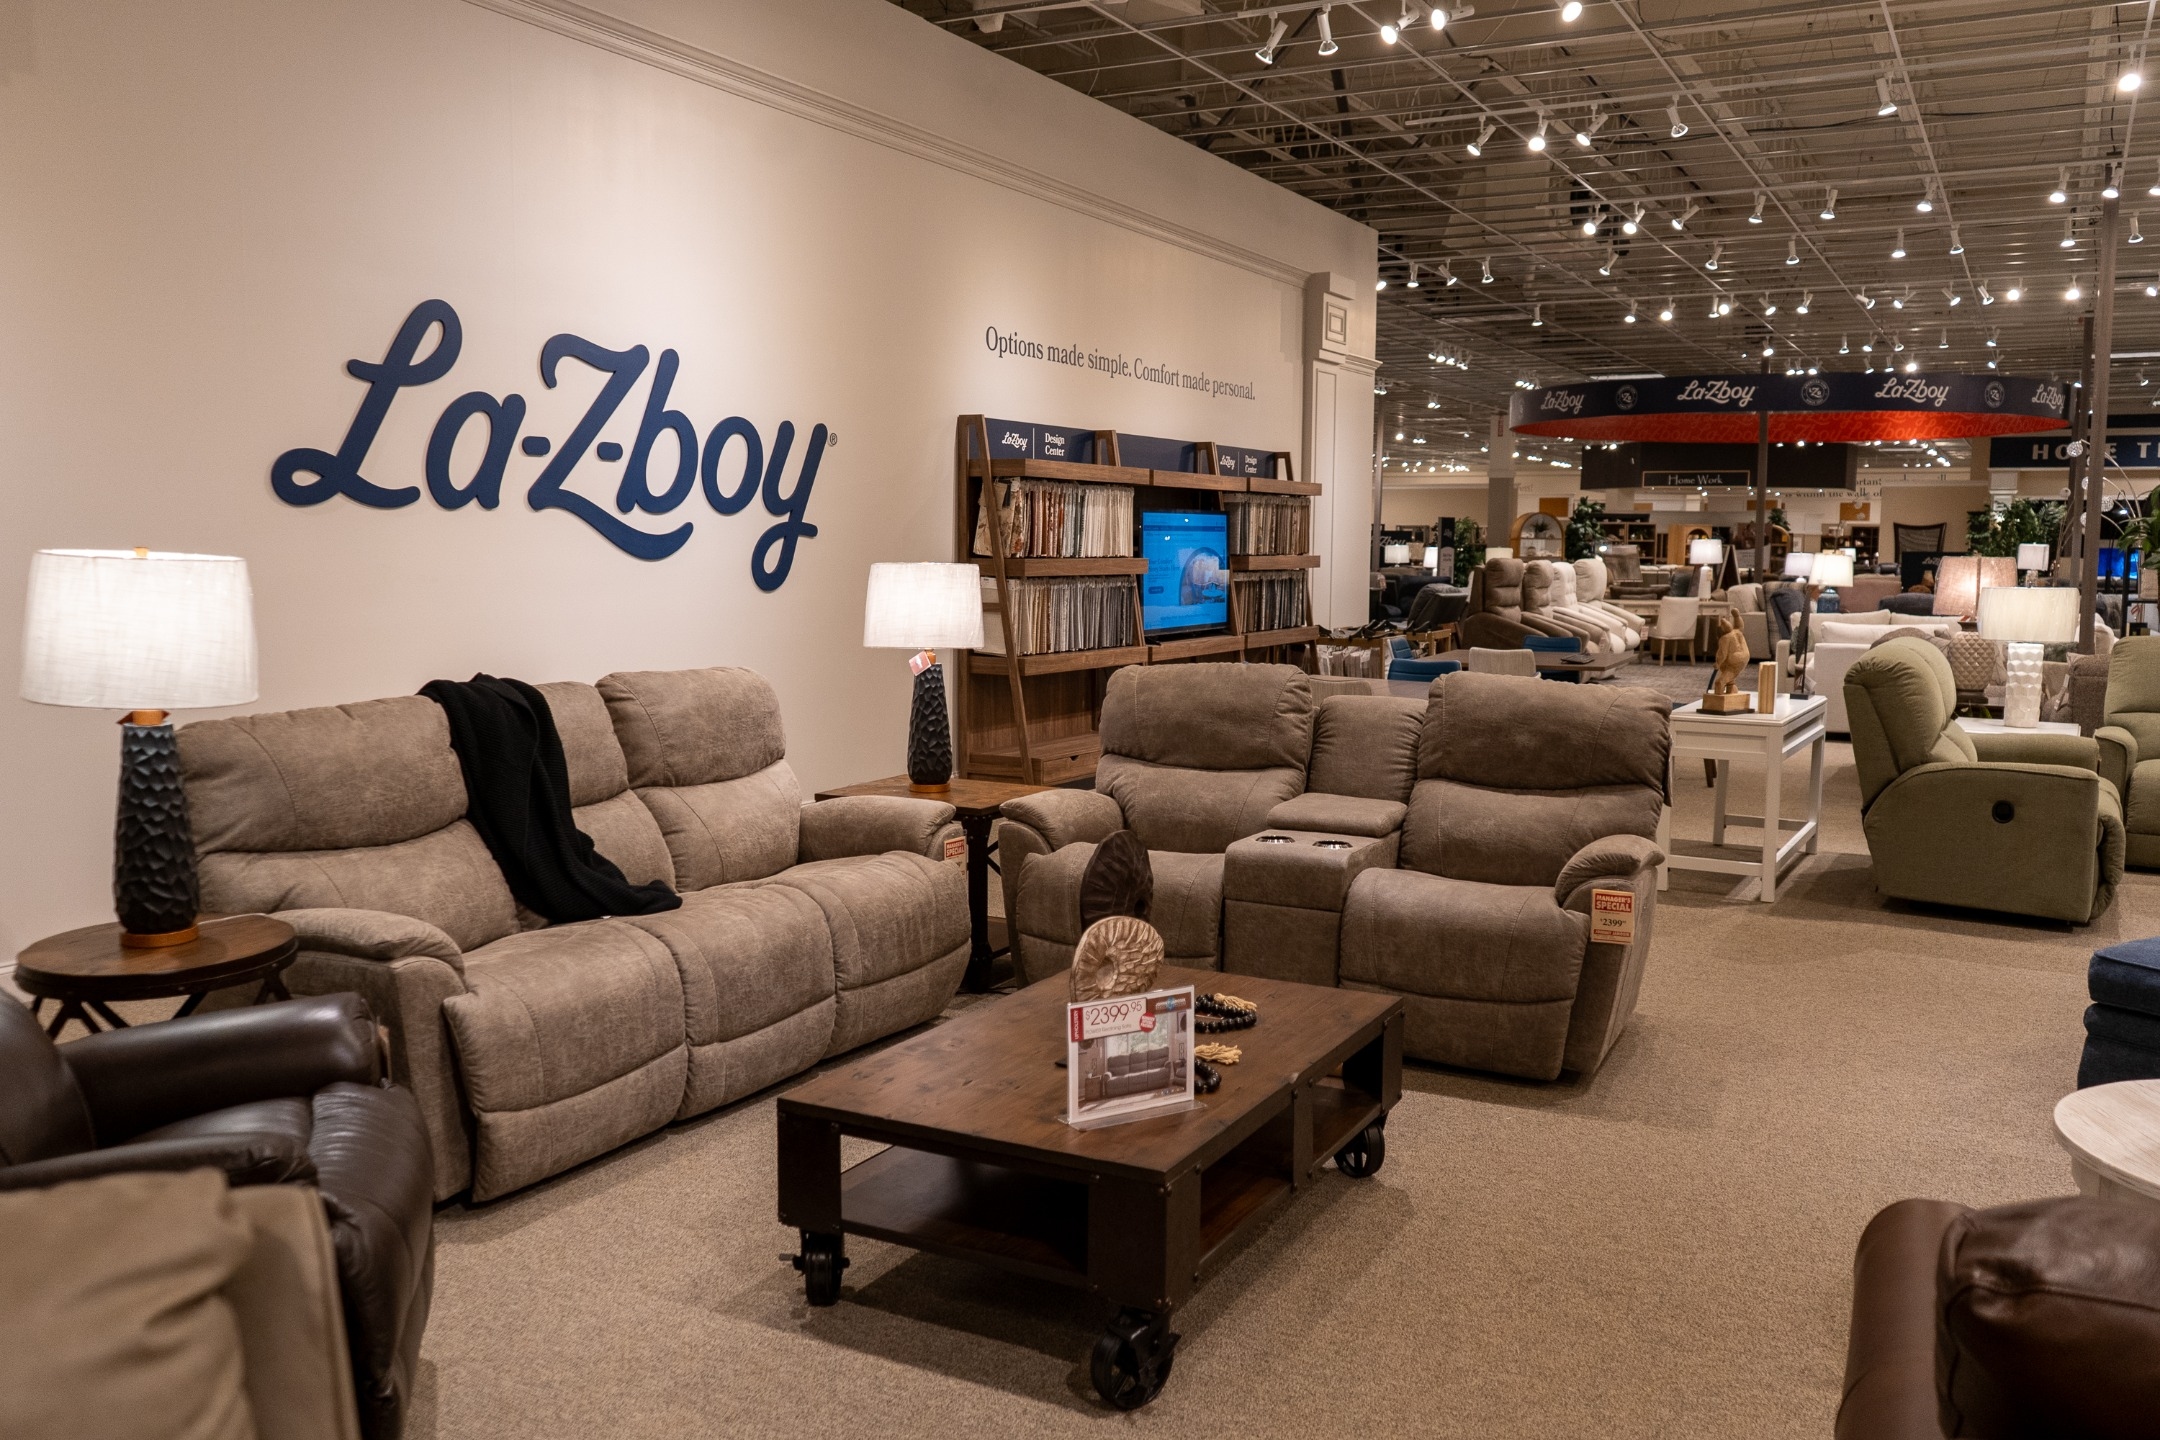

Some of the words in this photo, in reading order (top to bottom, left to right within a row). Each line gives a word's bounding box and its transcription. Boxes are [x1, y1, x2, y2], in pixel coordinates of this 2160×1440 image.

[986, 326, 1044, 359] Options
[1047, 344, 1085, 367] made
[1087, 348, 1132, 378] simple.
[1134, 357, 1180, 387] Comfort
[1182, 371, 1211, 392] made
[1212, 381, 1256, 401] personal.
[1045, 432, 1065, 446] Design
[1045, 445, 1065, 456] Center
[2032, 442, 2117, 461] HOE
[1245, 455, 1258, 465] Design
[1245, 464, 1258, 474] Center
[1668, 474, 1695, 485] Home
[1696, 473, 1723, 485] Work
[1596, 894, 1631, 904] MANAGER'S
[1596, 901, 1631, 912] SPECIAL
